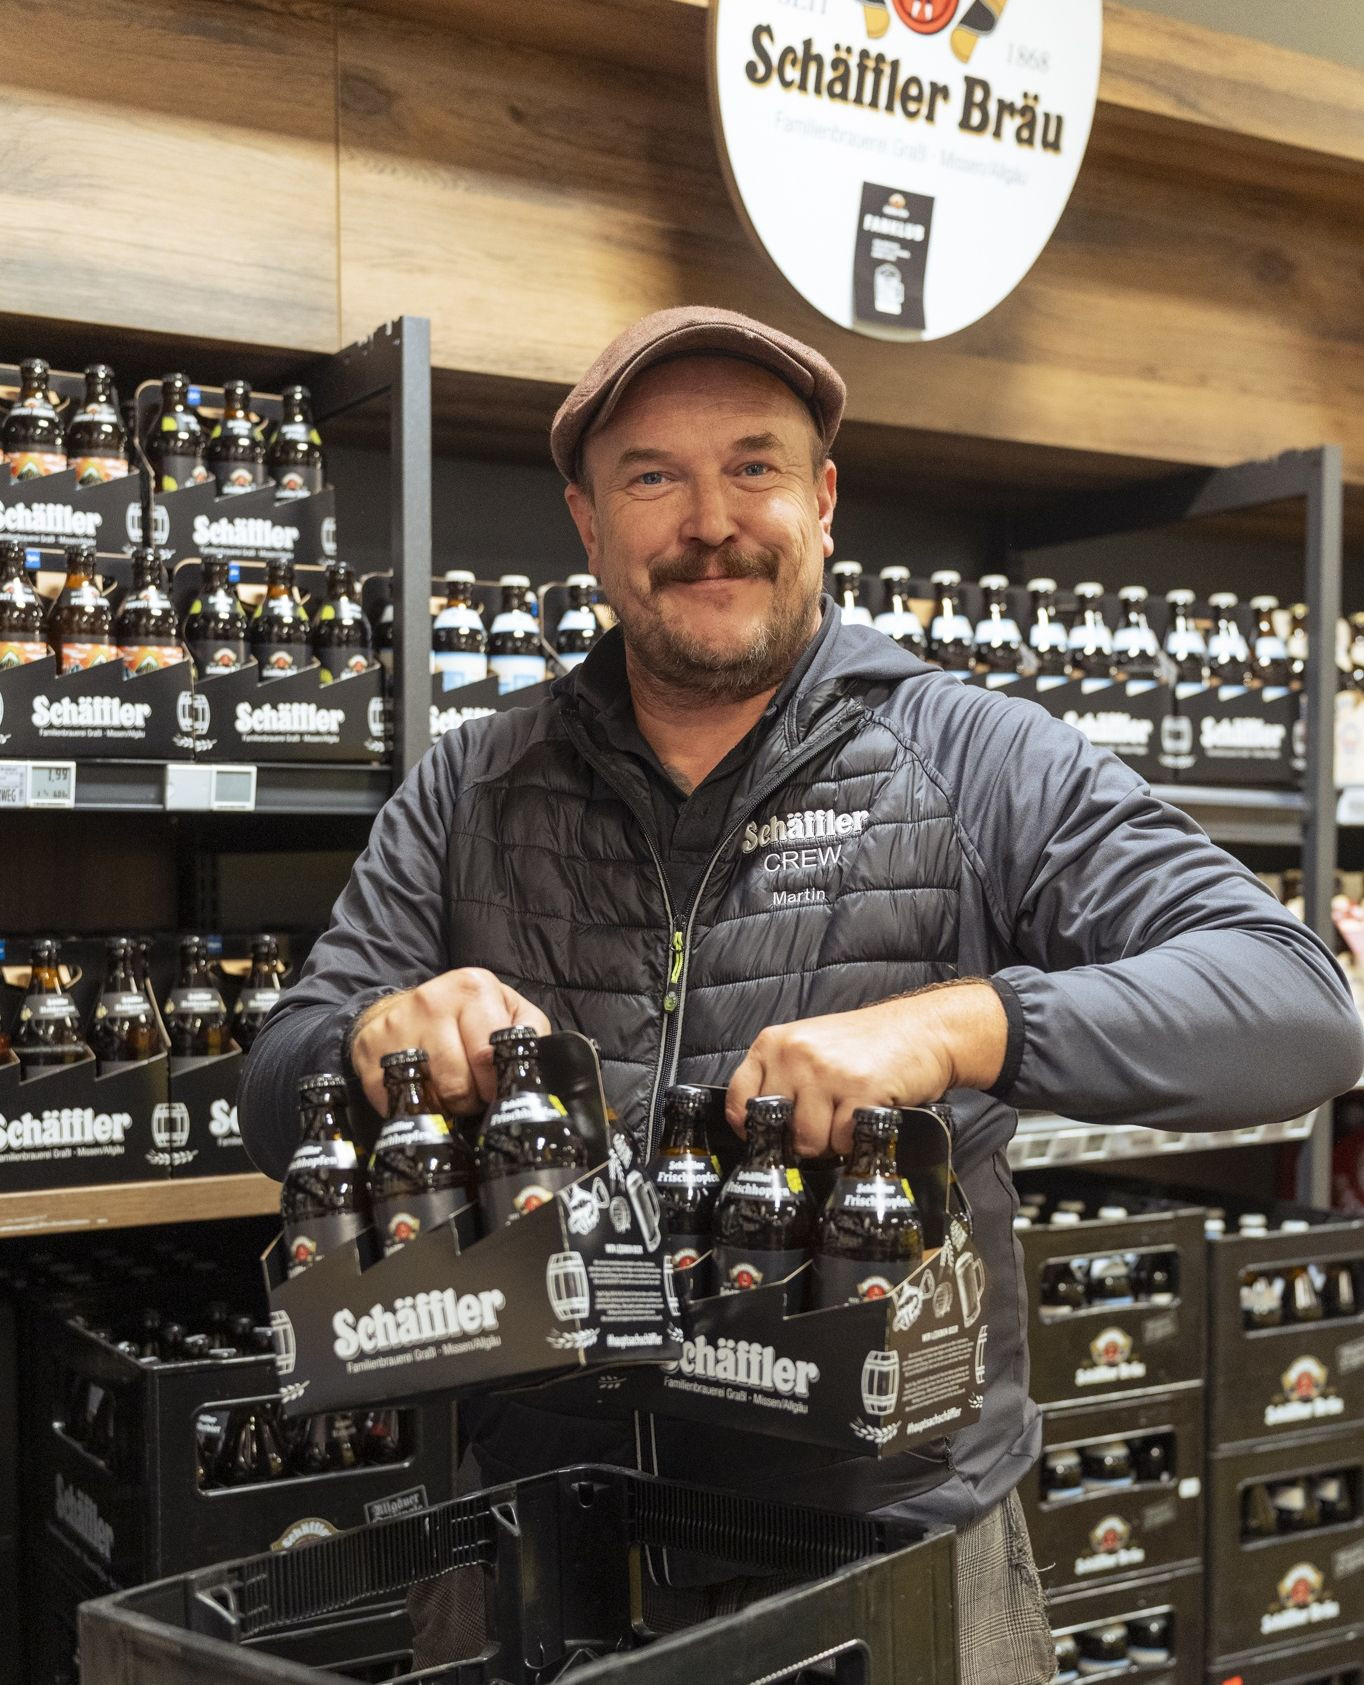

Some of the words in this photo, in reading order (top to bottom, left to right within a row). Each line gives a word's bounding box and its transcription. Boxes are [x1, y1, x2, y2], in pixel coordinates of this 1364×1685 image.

[1007, 42, 1050, 75] 1868
[745, 23, 950, 126] Schäffler
[958, 75, 1065, 154] Bräu
[32, 694, 152, 728] Schäffler
[235, 701, 345, 734] Schäffler
[742, 809, 870, 854] Schäffler
[764, 845, 842, 872] CREW
[773, 888, 825, 905] Martin
[332, 1287, 506, 1360] Schäffler
[661, 1335, 820, 1398] chäffler
